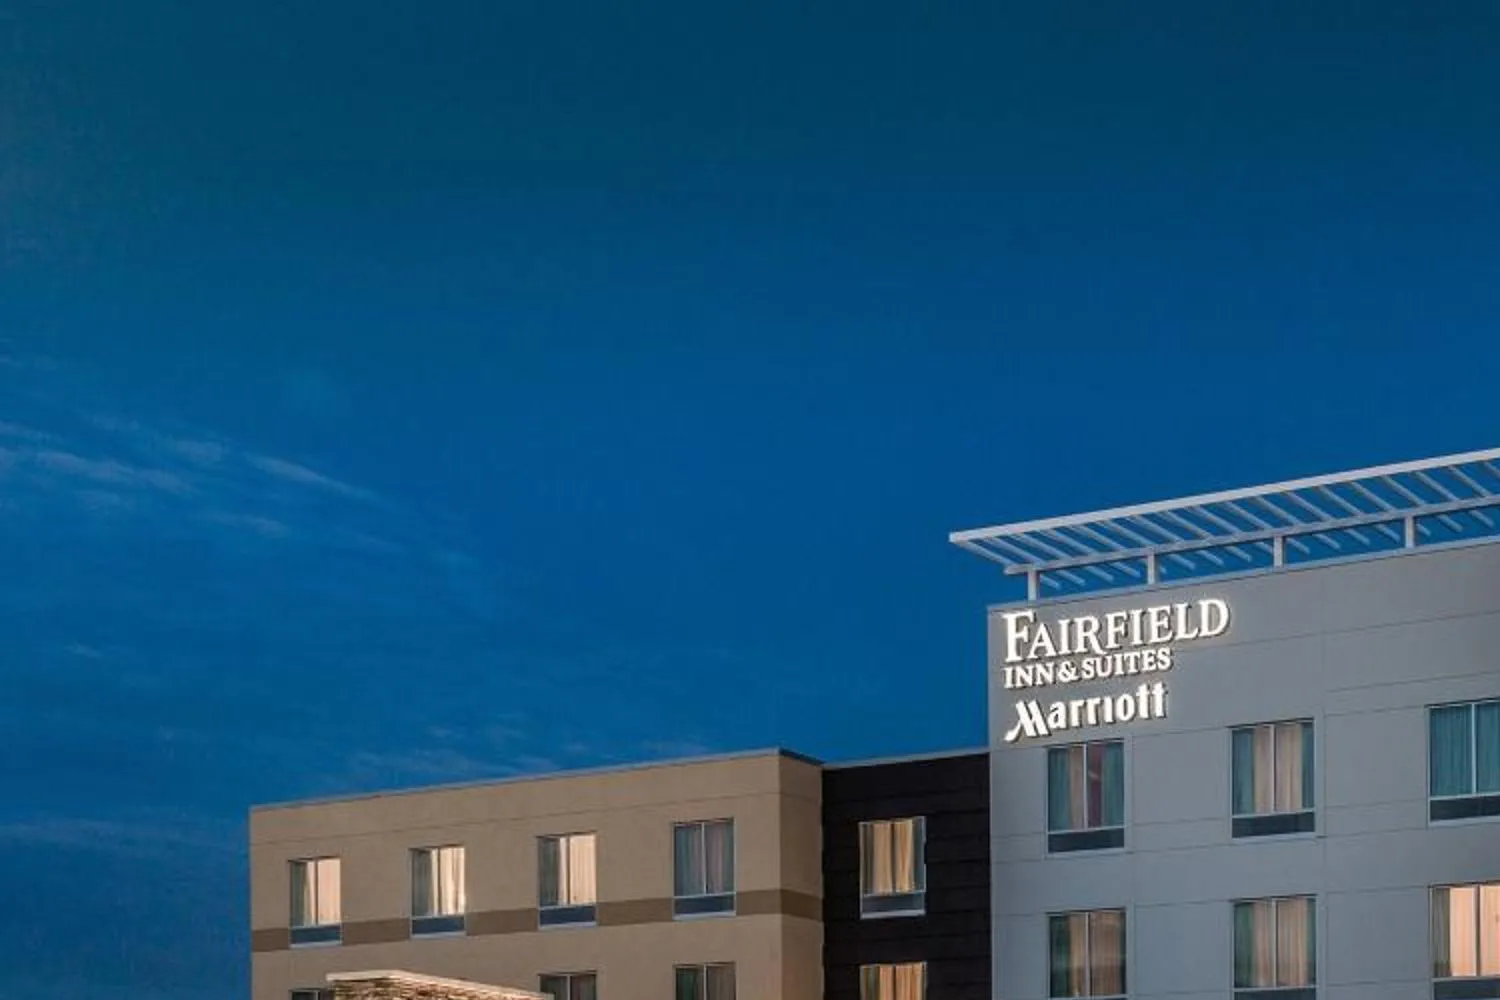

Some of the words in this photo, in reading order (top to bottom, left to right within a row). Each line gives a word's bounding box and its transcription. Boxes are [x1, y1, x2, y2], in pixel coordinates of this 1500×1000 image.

[1003, 599, 1230, 663] FAIRFIELD
[1081, 648, 1173, 680] SUITES
[1003, 681, 1169, 742] Marriott
